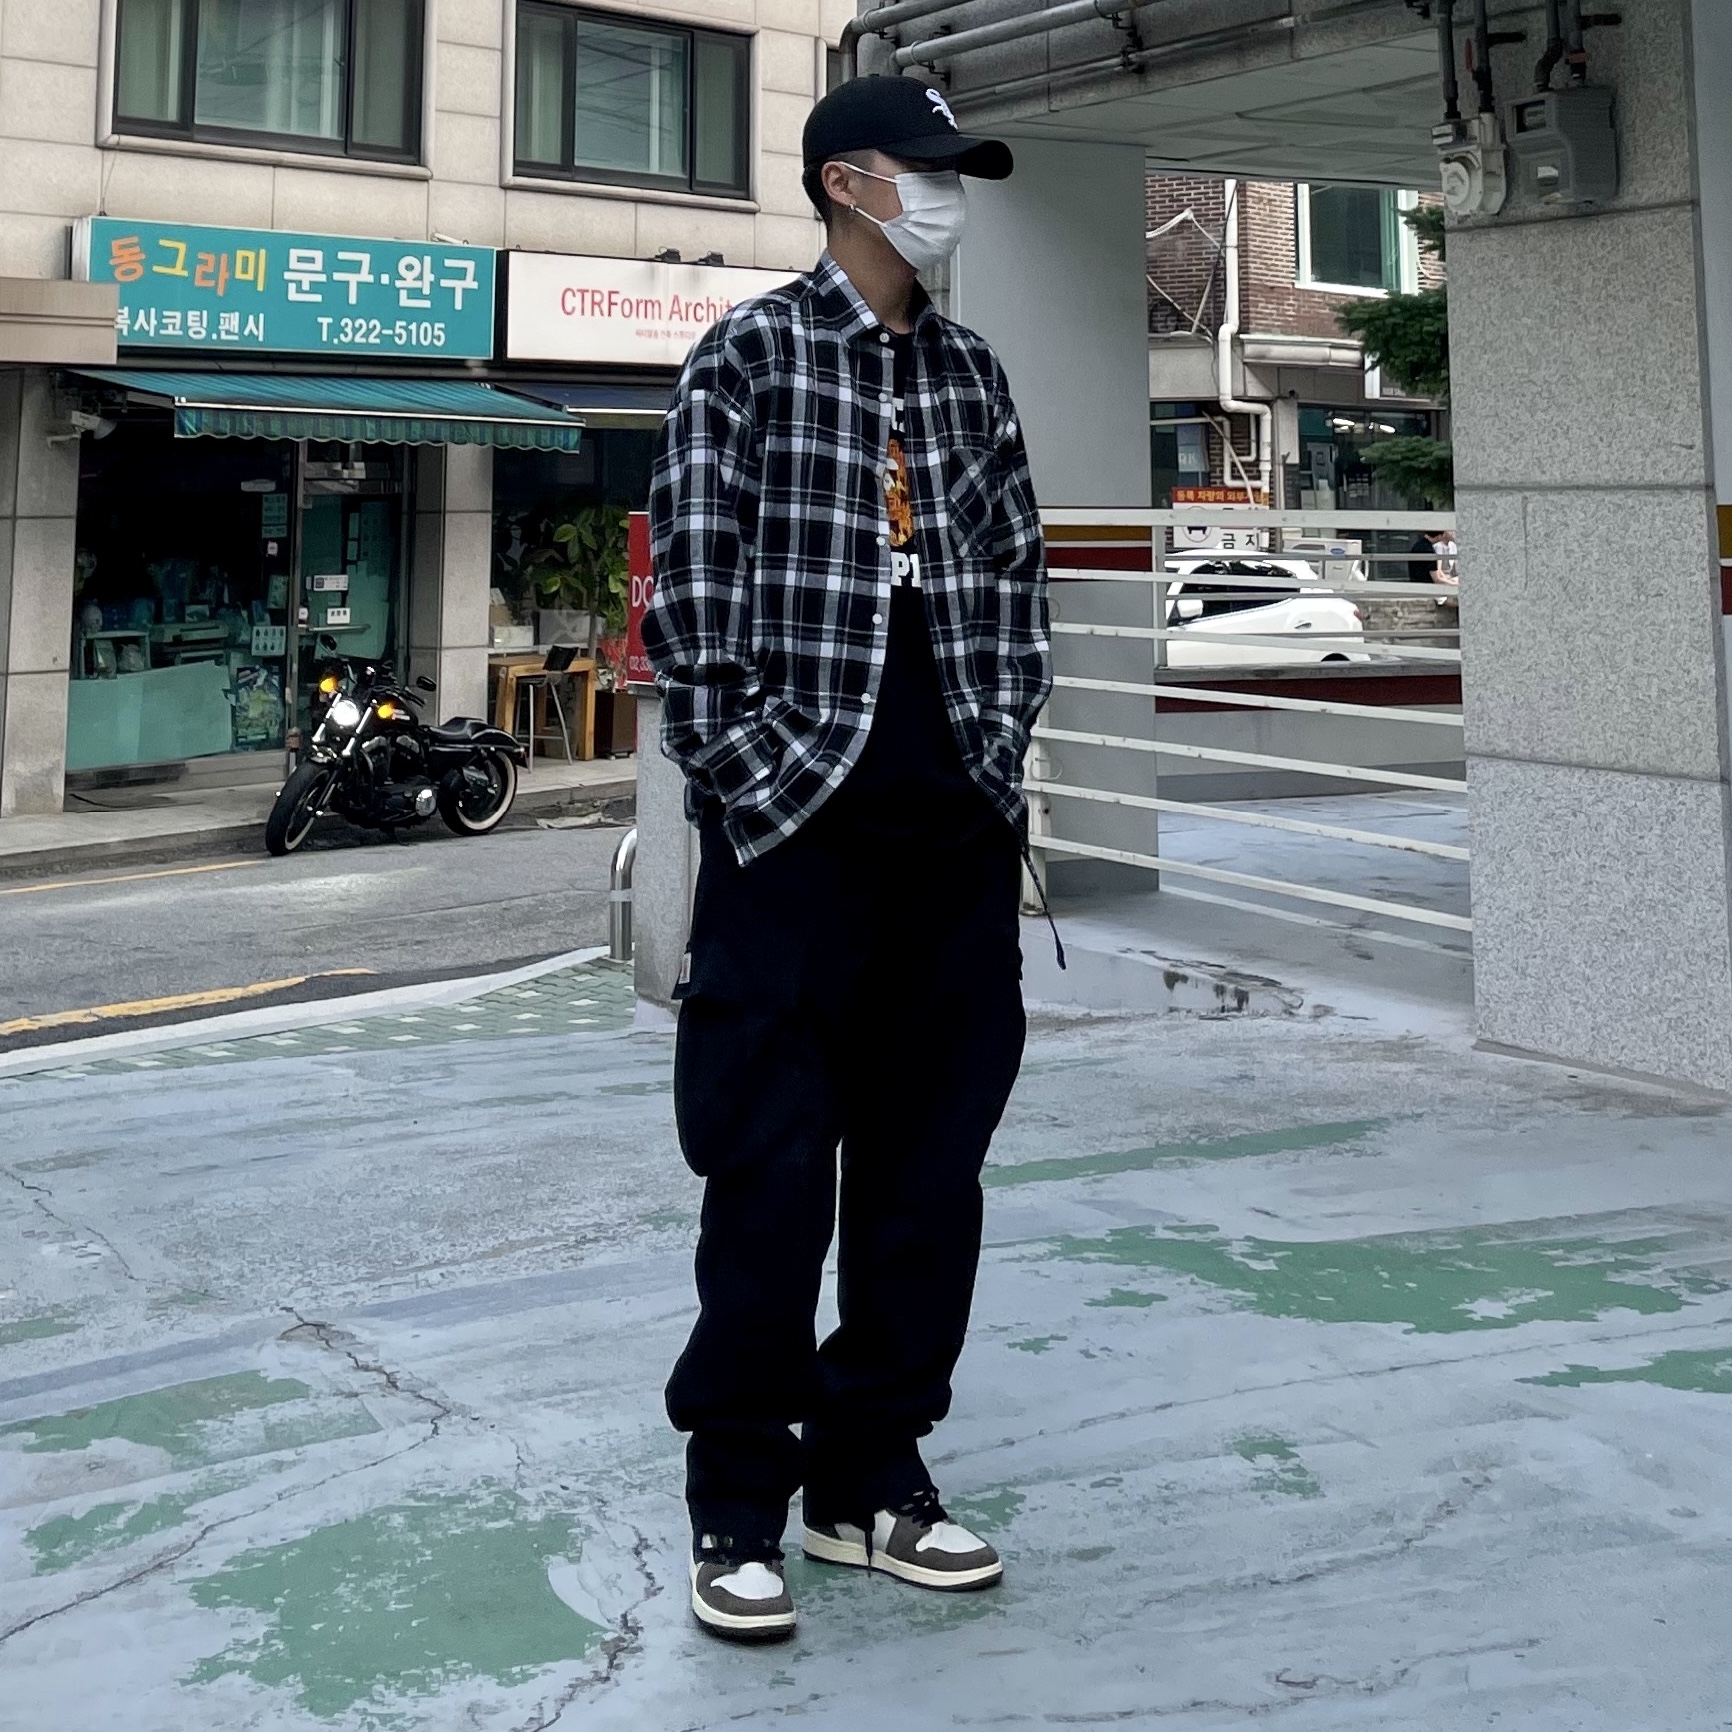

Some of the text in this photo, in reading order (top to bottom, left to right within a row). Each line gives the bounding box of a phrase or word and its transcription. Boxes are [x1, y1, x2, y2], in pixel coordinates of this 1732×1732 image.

[109, 236, 266, 297] 동그라미
[561, 287, 662, 321] CTRForm
[316, 316, 446, 347] T.322-5105
